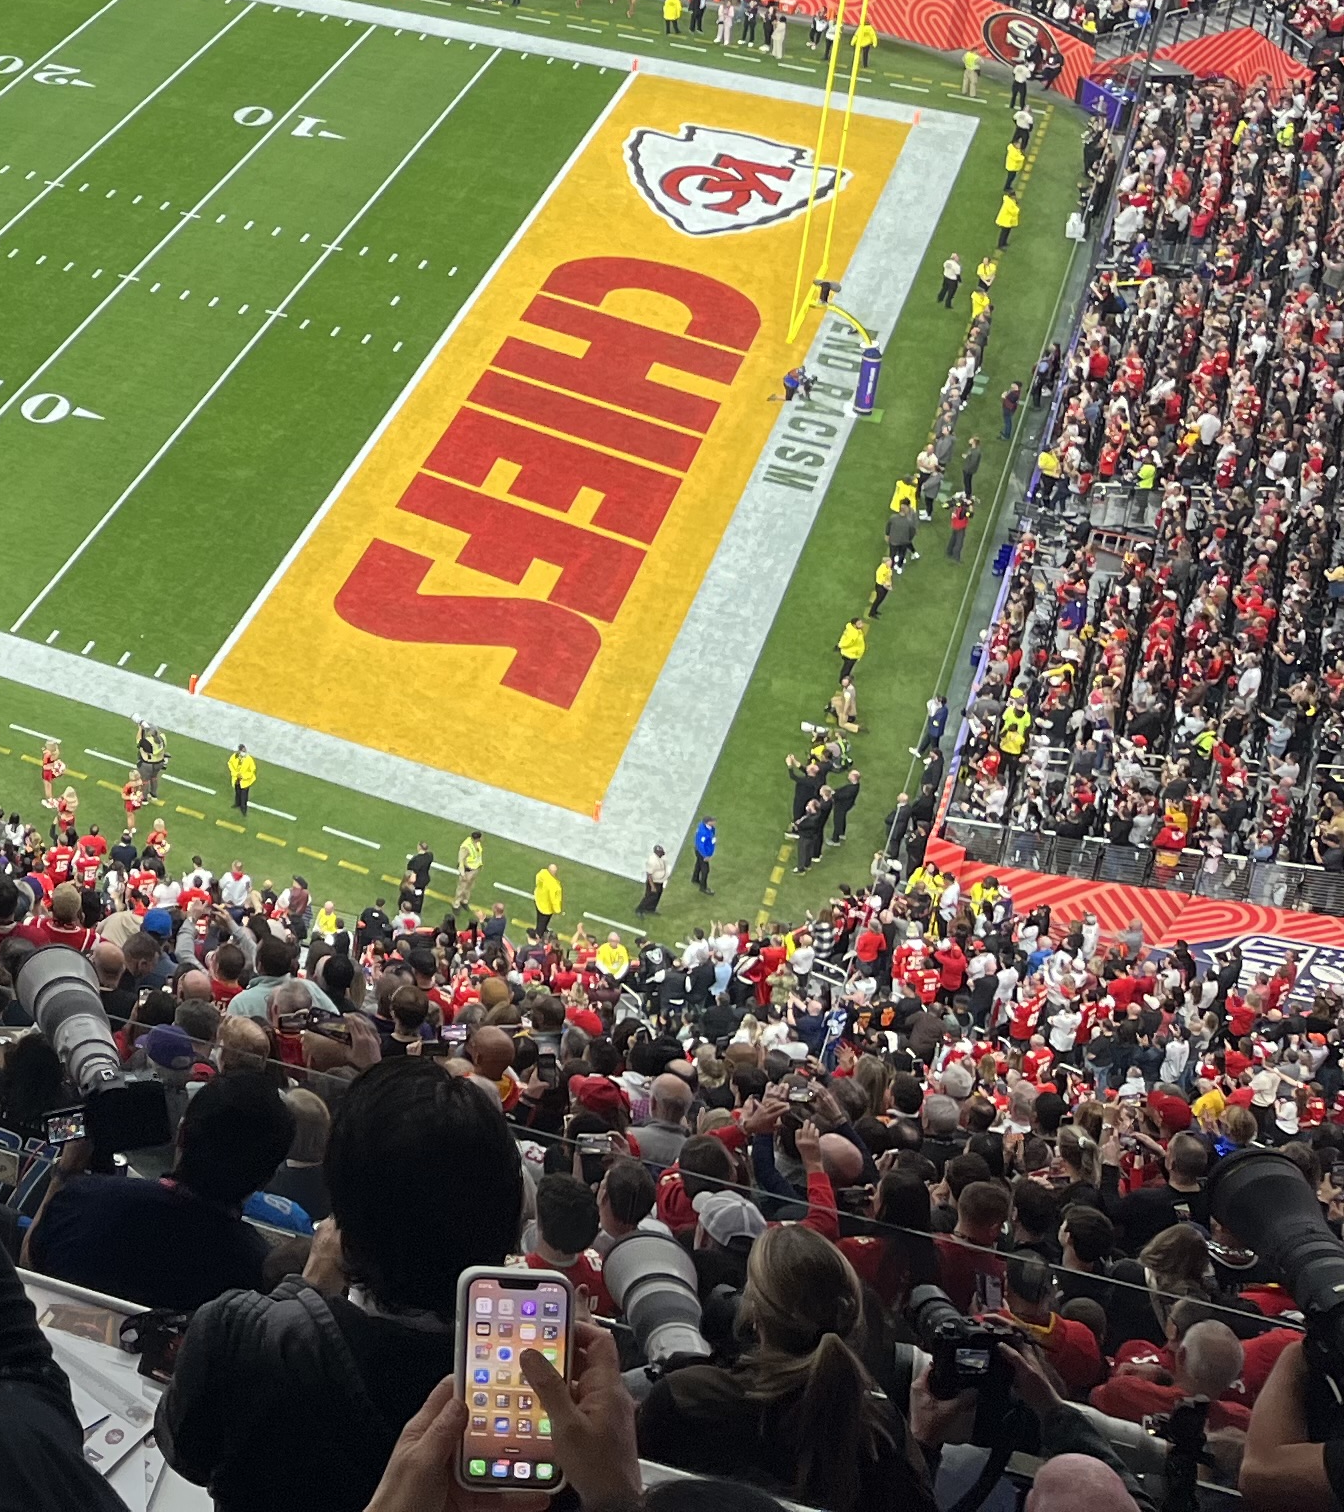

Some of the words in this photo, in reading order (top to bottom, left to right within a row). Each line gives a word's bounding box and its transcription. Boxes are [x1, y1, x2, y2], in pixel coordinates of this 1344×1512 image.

[233, 106, 327, 138] 10
[333, 257, 762, 710] CHIEFS
[762, 381, 854, 493] RACISM
